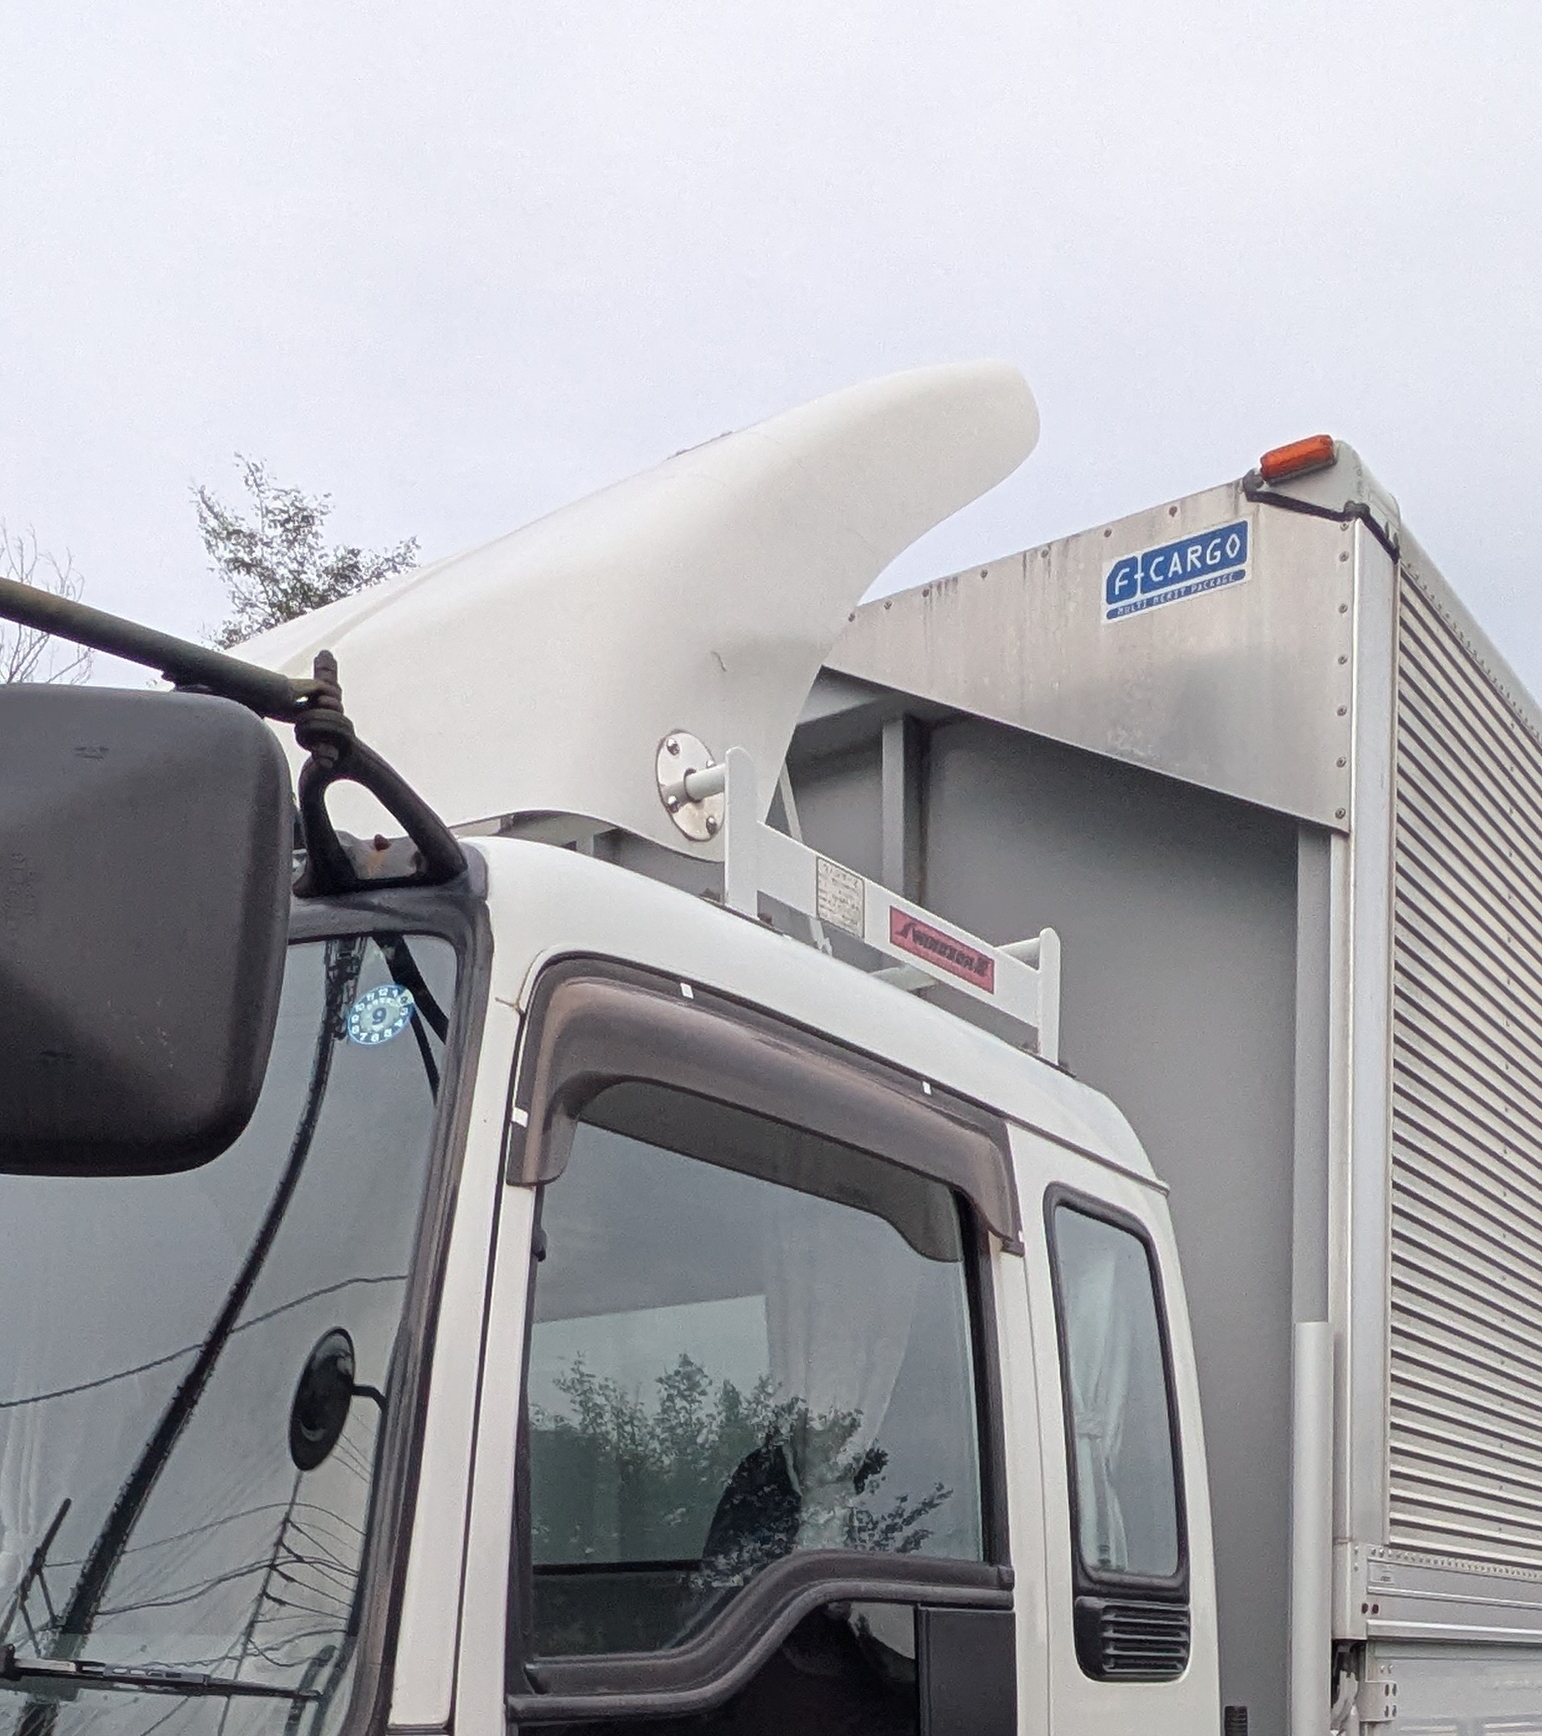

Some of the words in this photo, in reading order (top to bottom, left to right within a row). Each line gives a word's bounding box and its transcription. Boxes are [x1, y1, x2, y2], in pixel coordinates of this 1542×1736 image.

[1114, 533, 1241, 596] F-CARGO
[1117, 599, 1147, 615] MULTI
[1153, 587, 1187, 605] MERIT
[1190, 573, 1235, 593] PACKAGE
[371, 1006, 387, 1026] 9
